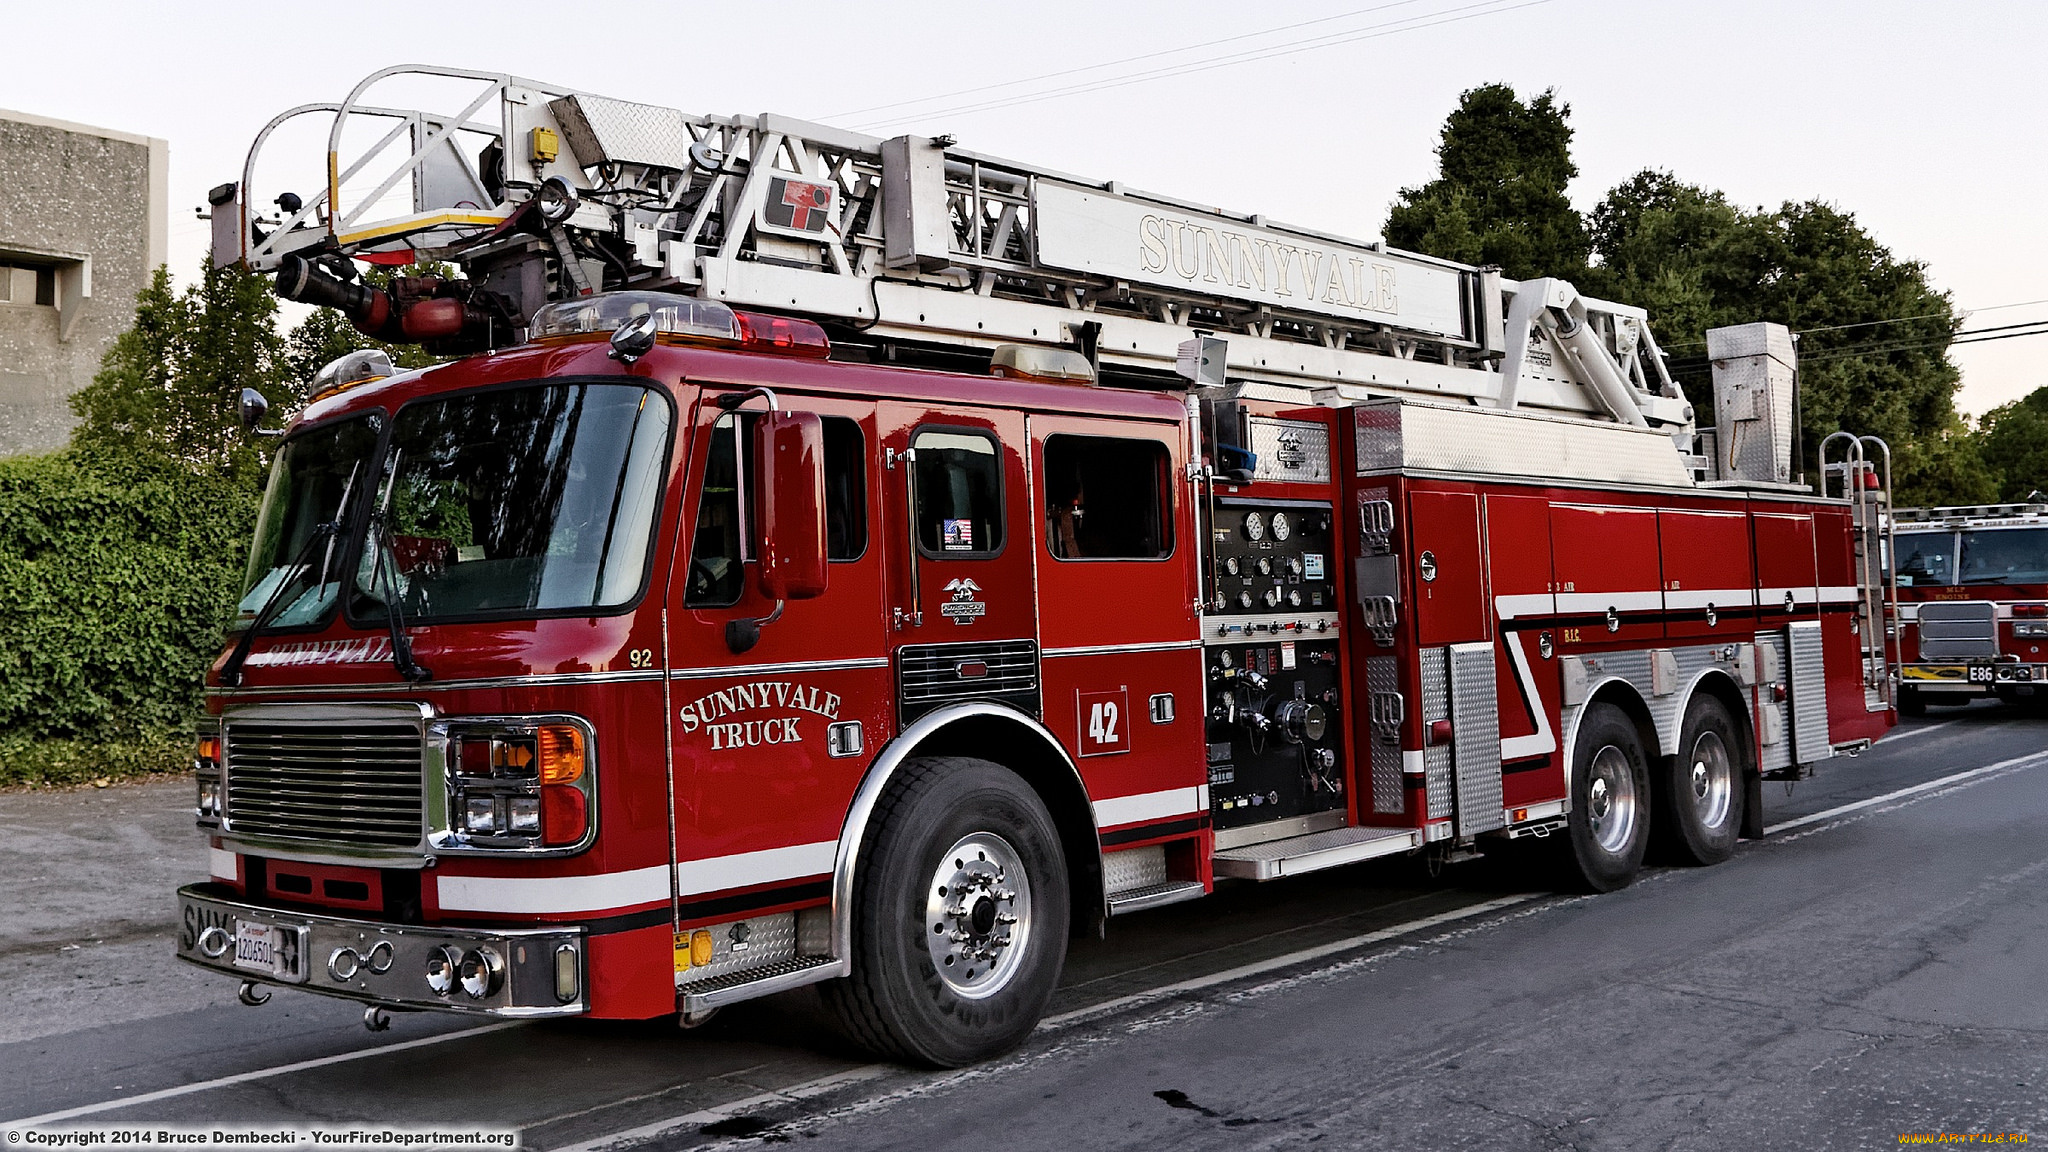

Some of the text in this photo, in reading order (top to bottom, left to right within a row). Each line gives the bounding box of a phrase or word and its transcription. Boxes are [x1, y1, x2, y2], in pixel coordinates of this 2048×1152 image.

[1139, 214, 1399, 316] SUNNYVALE
[1563, 581, 1575, 592] AIR
[630, 649, 652, 668] 92
[1970, 666, 1993, 681] E86
[680, 682, 841, 733] SUNNYVALE
[1089, 701, 1119, 744] 42
[706, 717, 802, 750] TRUCK
[237, 938, 274, 965] 1206501
